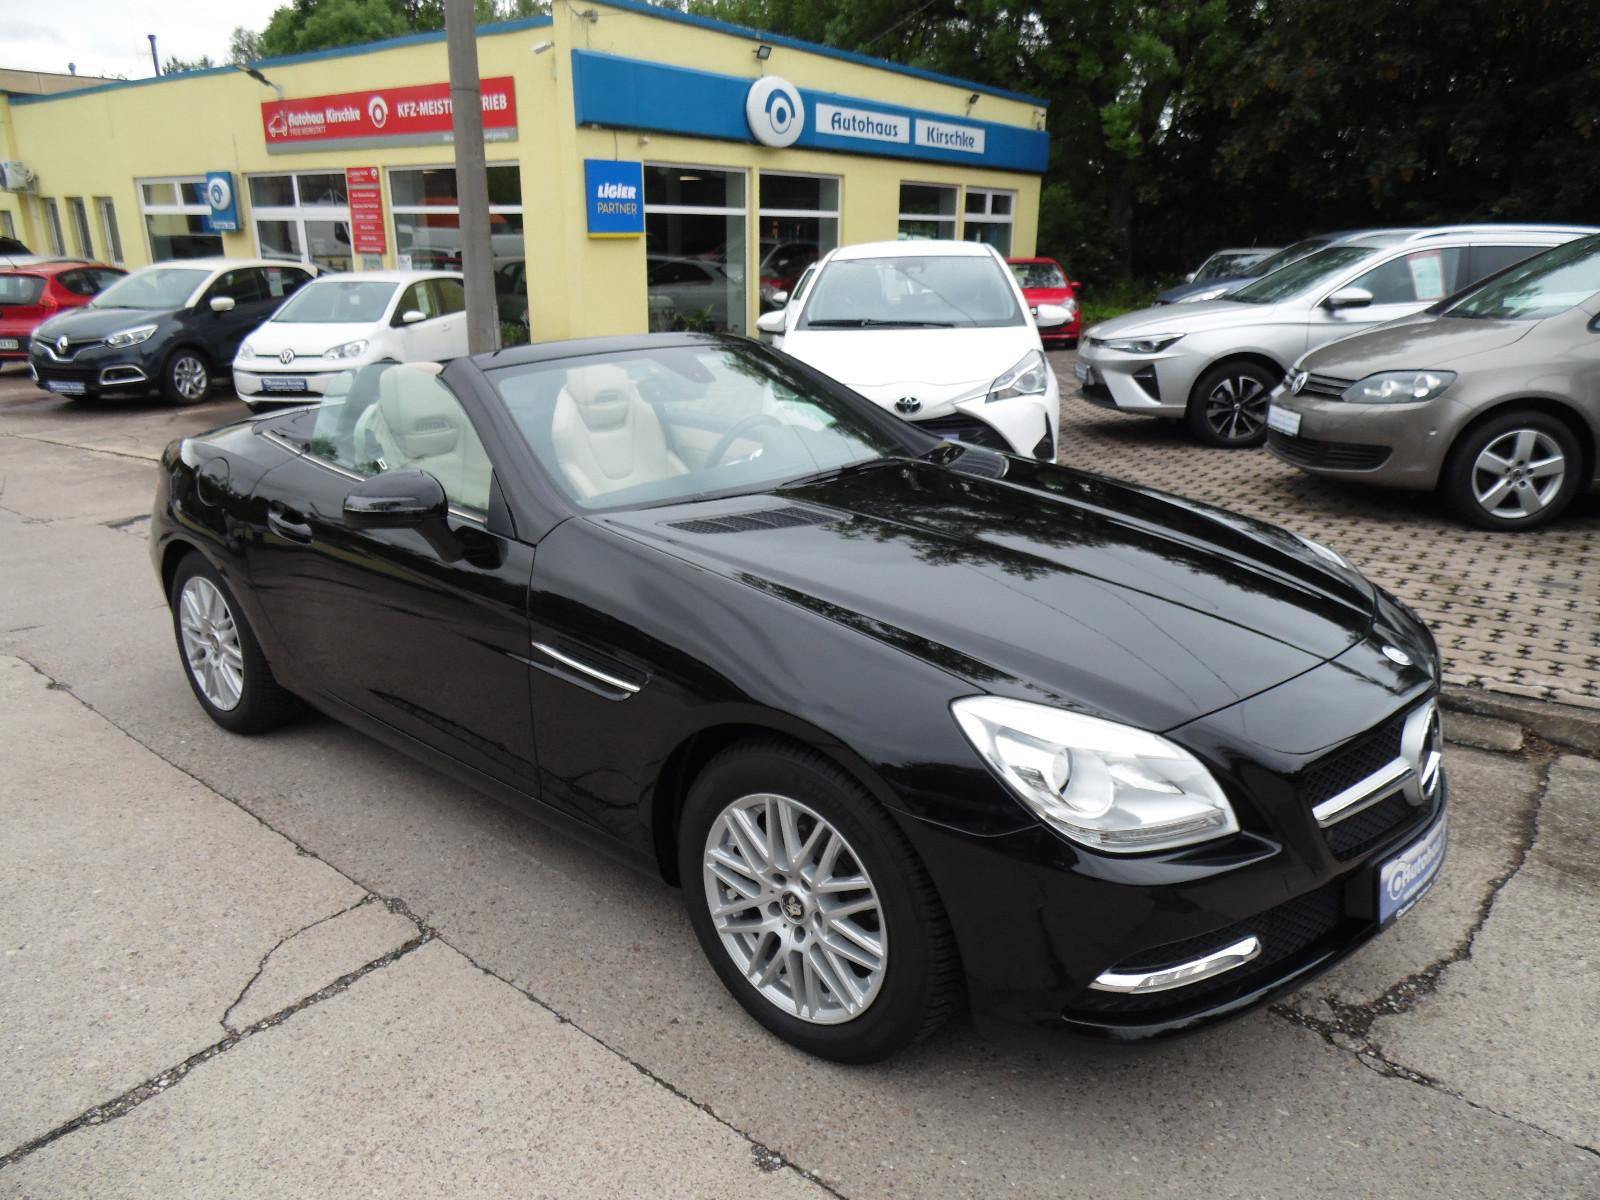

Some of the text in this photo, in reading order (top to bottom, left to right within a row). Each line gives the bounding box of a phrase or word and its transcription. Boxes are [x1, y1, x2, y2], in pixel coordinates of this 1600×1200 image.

[288, 107, 361, 128] Autohaus Kirschke
[831, 112, 975, 148] Autohaus Kirschke
[597, 202, 638, 215] PARTNER
